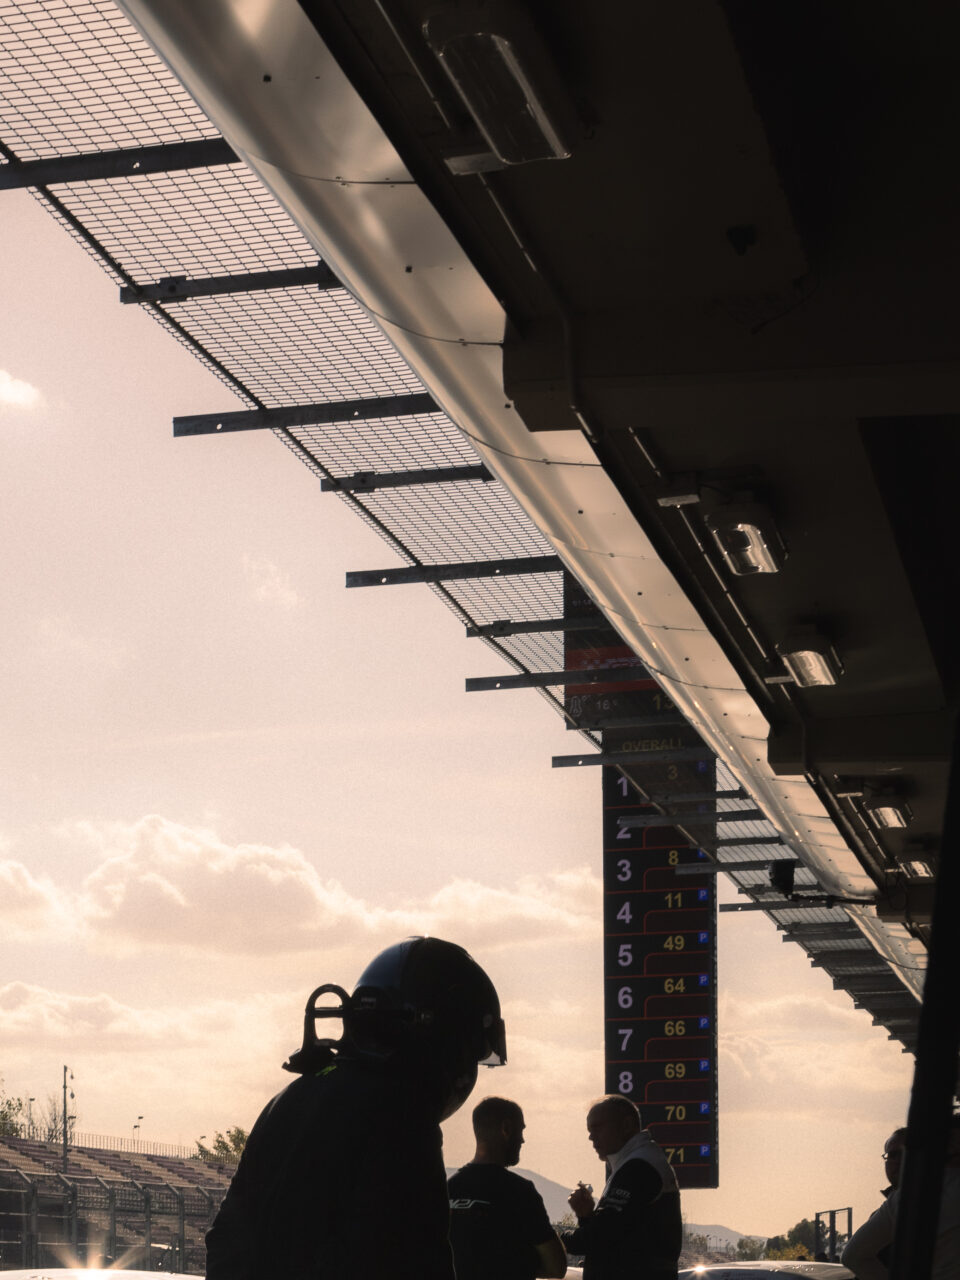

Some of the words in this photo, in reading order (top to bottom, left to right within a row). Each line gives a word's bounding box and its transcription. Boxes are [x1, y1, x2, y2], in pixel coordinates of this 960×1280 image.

[622, 738, 685, 752] OVERALL
[667, 764, 679, 780] 3
[617, 777, 628, 797] 1
[668, 850, 679, 865] 8
[617, 859, 632, 882] 3
[664, 892, 683, 908] 11
[616, 901, 632, 924] 4
[663, 935, 685, 950] 49
[618, 944, 633, 967] 5
[664, 978, 686, 993] 64
[618, 986, 633, 1008] 6
[664, 1020, 686, 1036] 66
[618, 1029, 633, 1051] 7
[665, 1063, 686, 1078] 69
[618, 1071, 633, 1094] 8
[665, 1105, 686, 1120] 70
[665, 1147, 685, 1164] 71
